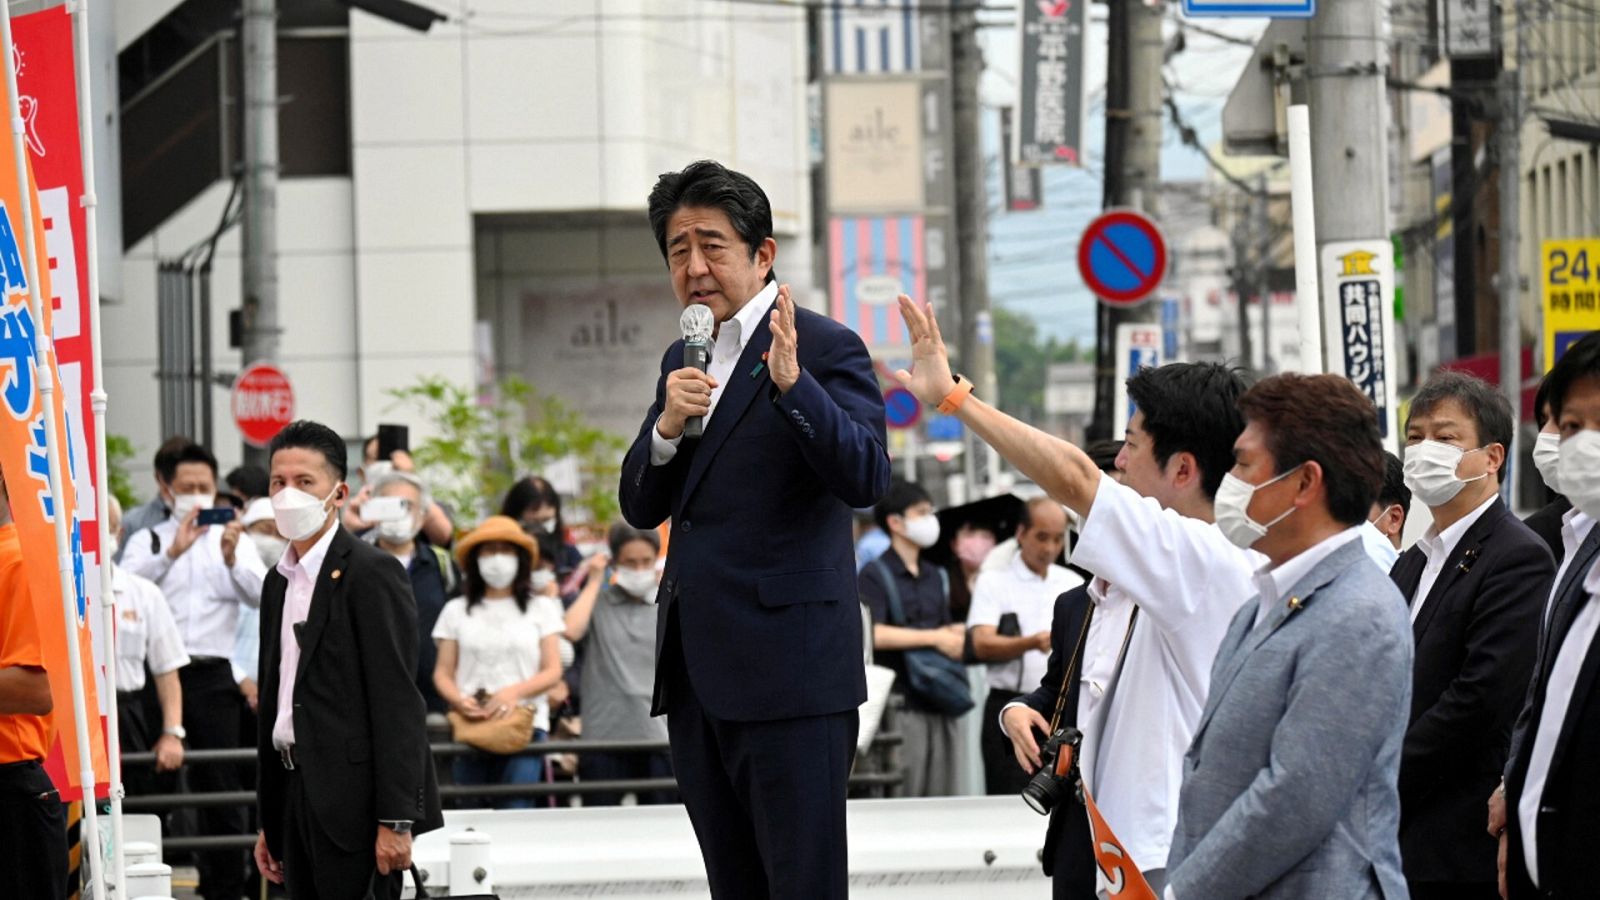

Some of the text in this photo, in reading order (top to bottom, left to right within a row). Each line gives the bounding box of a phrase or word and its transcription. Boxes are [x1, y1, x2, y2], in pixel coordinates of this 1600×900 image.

[849, 106, 900, 141] aile
[1549, 247, 1600, 285] 24
[1549, 291, 1600, 312] 時間
[570, 299, 642, 346] aile
